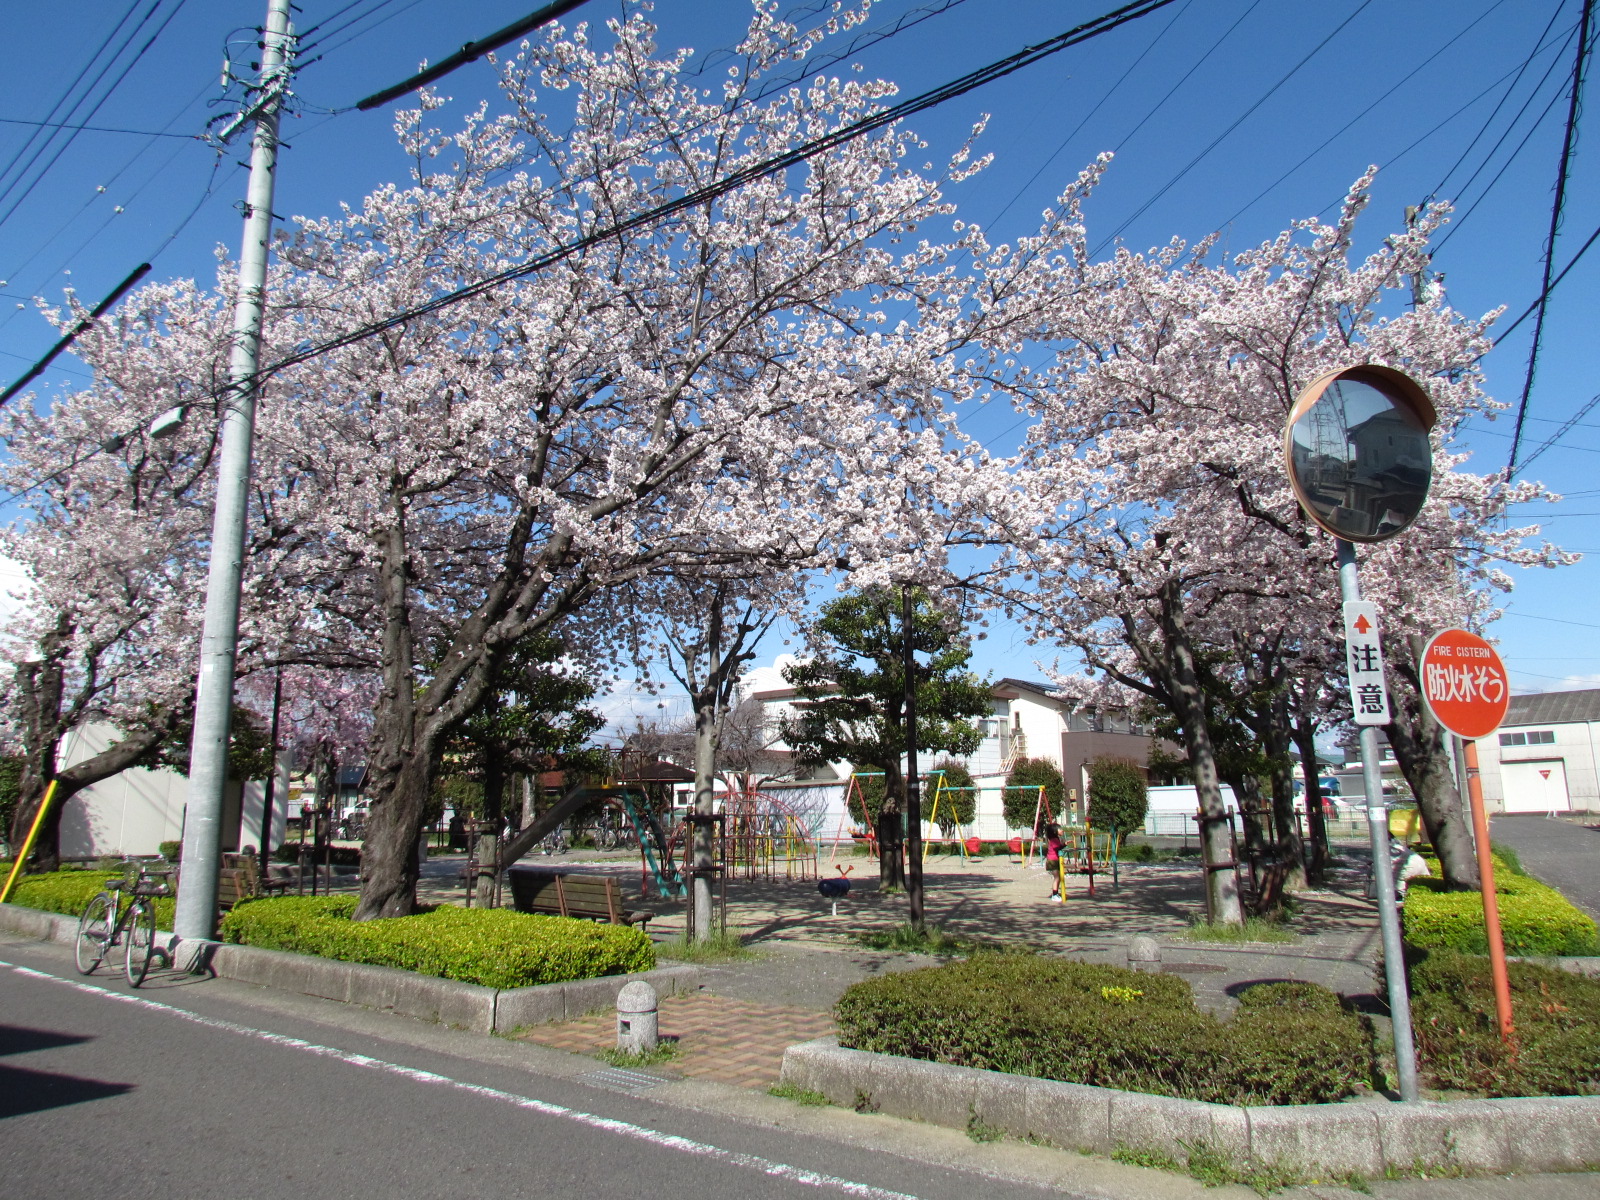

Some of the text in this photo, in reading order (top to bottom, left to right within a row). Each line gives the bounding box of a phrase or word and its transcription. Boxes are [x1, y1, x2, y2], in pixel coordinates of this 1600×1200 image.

[1433, 645, 1490, 658] FIRE CISTERN
[1352, 643, 1384, 714] 注意
[1426, 663, 1504, 703] 防火水そう
